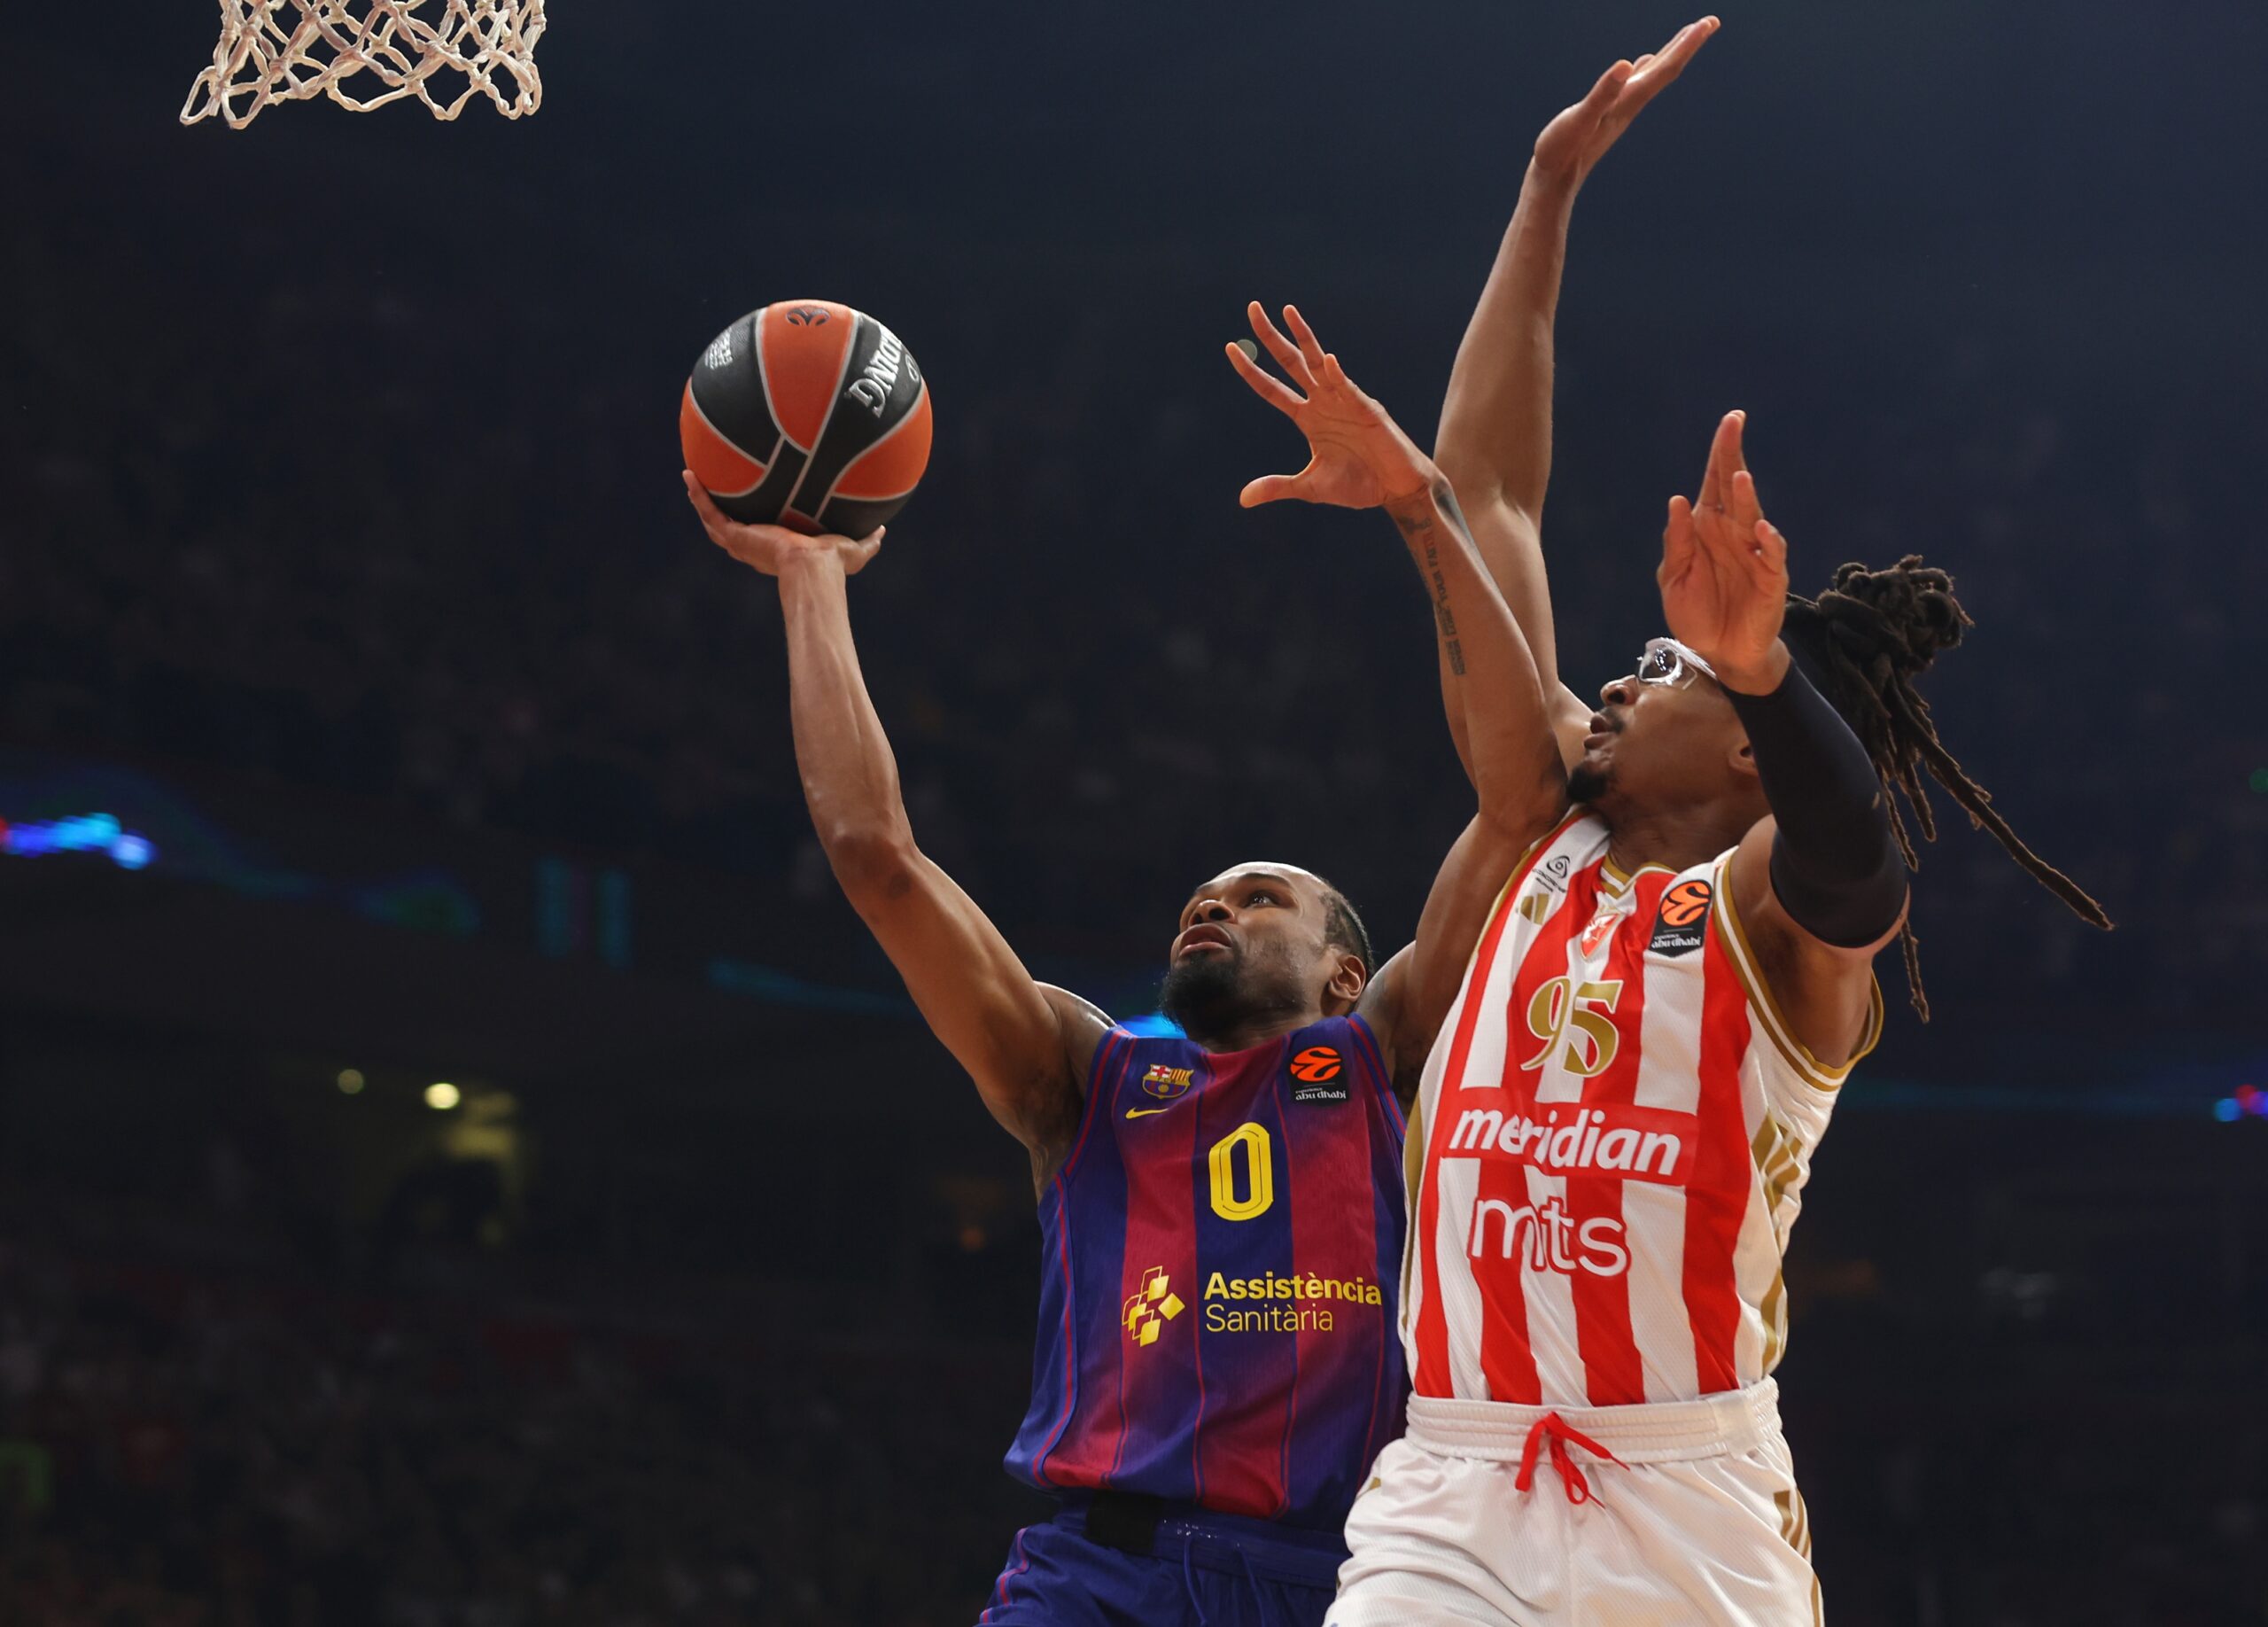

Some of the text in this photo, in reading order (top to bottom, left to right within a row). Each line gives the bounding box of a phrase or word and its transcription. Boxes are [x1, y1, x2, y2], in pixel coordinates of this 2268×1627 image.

[1520, 976, 1624, 1078] 95
[1295, 1090, 1347, 1101] abu dhabi
[1208, 1122, 1274, 1221] 0
[1449, 1109, 1682, 1176] meridian
[1471, 1200, 1628, 1277] mts
[1204, 1271, 1382, 1305] Assistència
[1206, 1303, 1333, 1332] Sanitària
